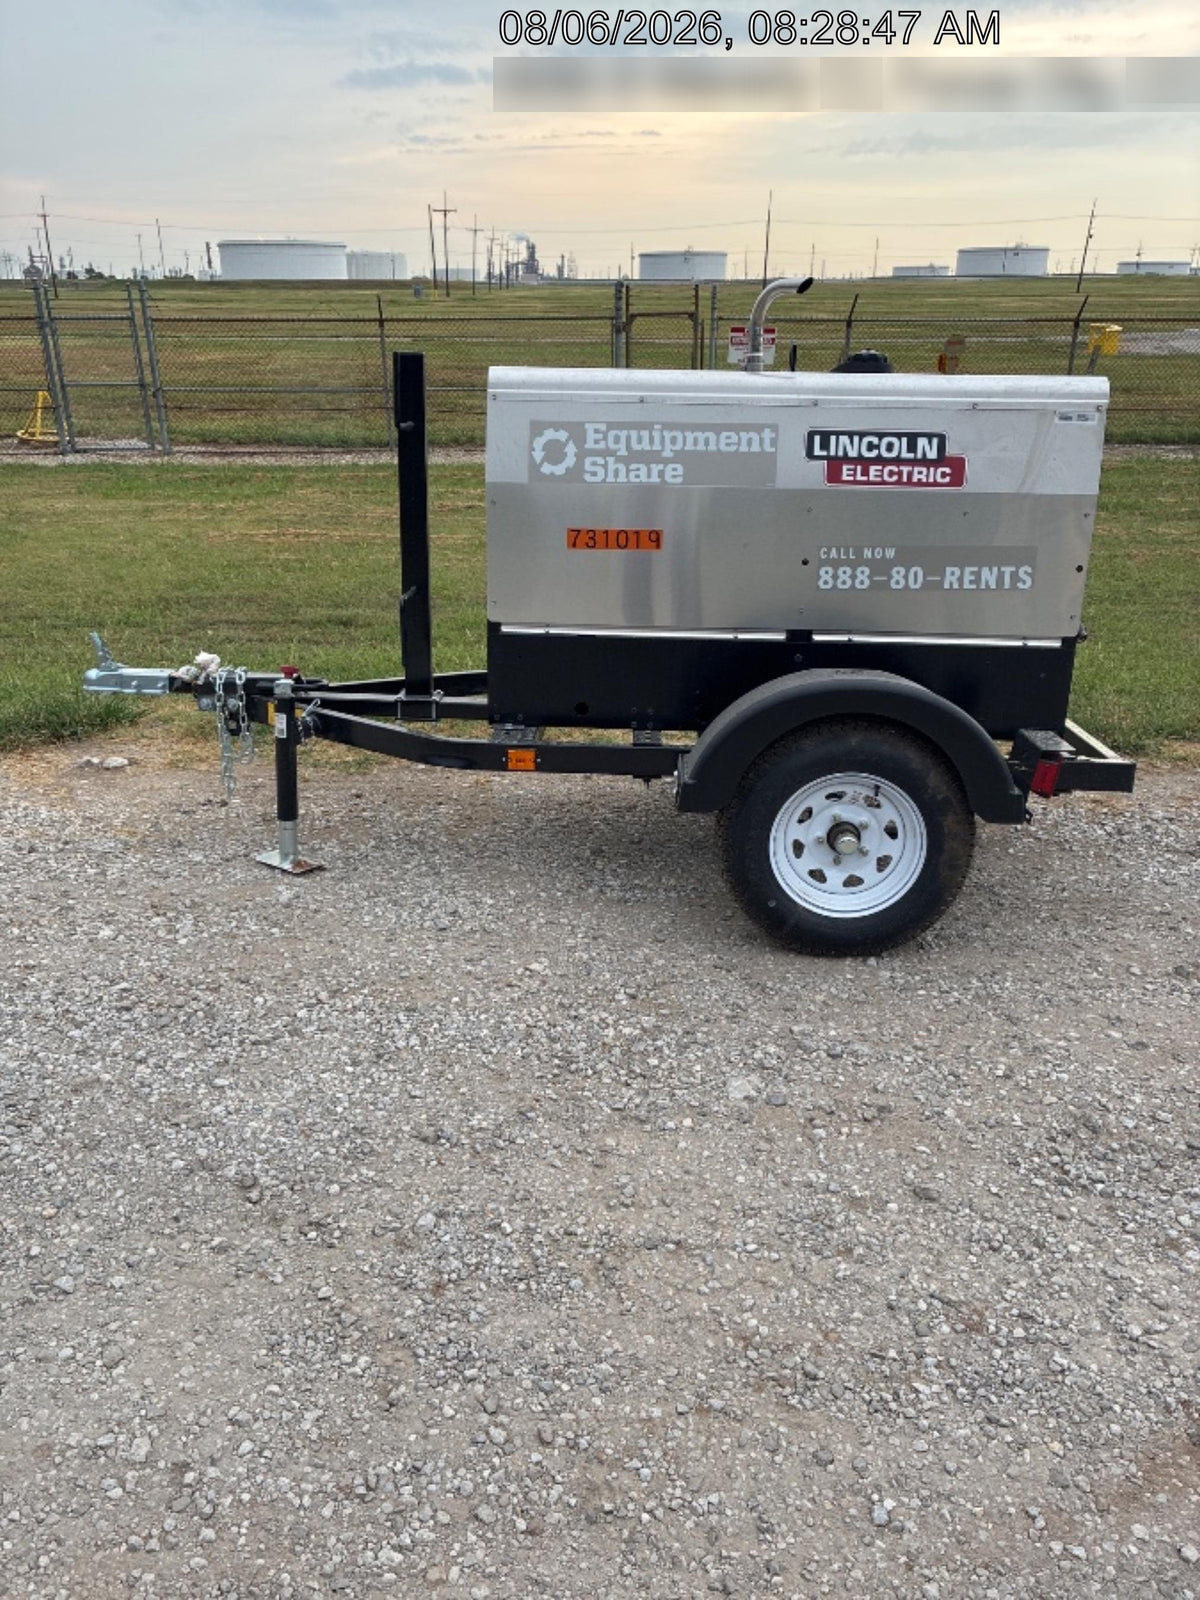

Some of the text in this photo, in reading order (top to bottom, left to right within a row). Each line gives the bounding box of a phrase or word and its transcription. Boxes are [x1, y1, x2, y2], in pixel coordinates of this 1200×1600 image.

[584, 423, 776, 457] Equipment
[813, 434, 939, 459] LINCOLN
[583, 456, 684, 484] Share
[841, 465, 952, 483] ELECTRIC
[570, 529, 661, 549] 731019
[820, 547, 896, 559] CALL NOW
[817, 565, 1033, 590] 888-80-RENTS
